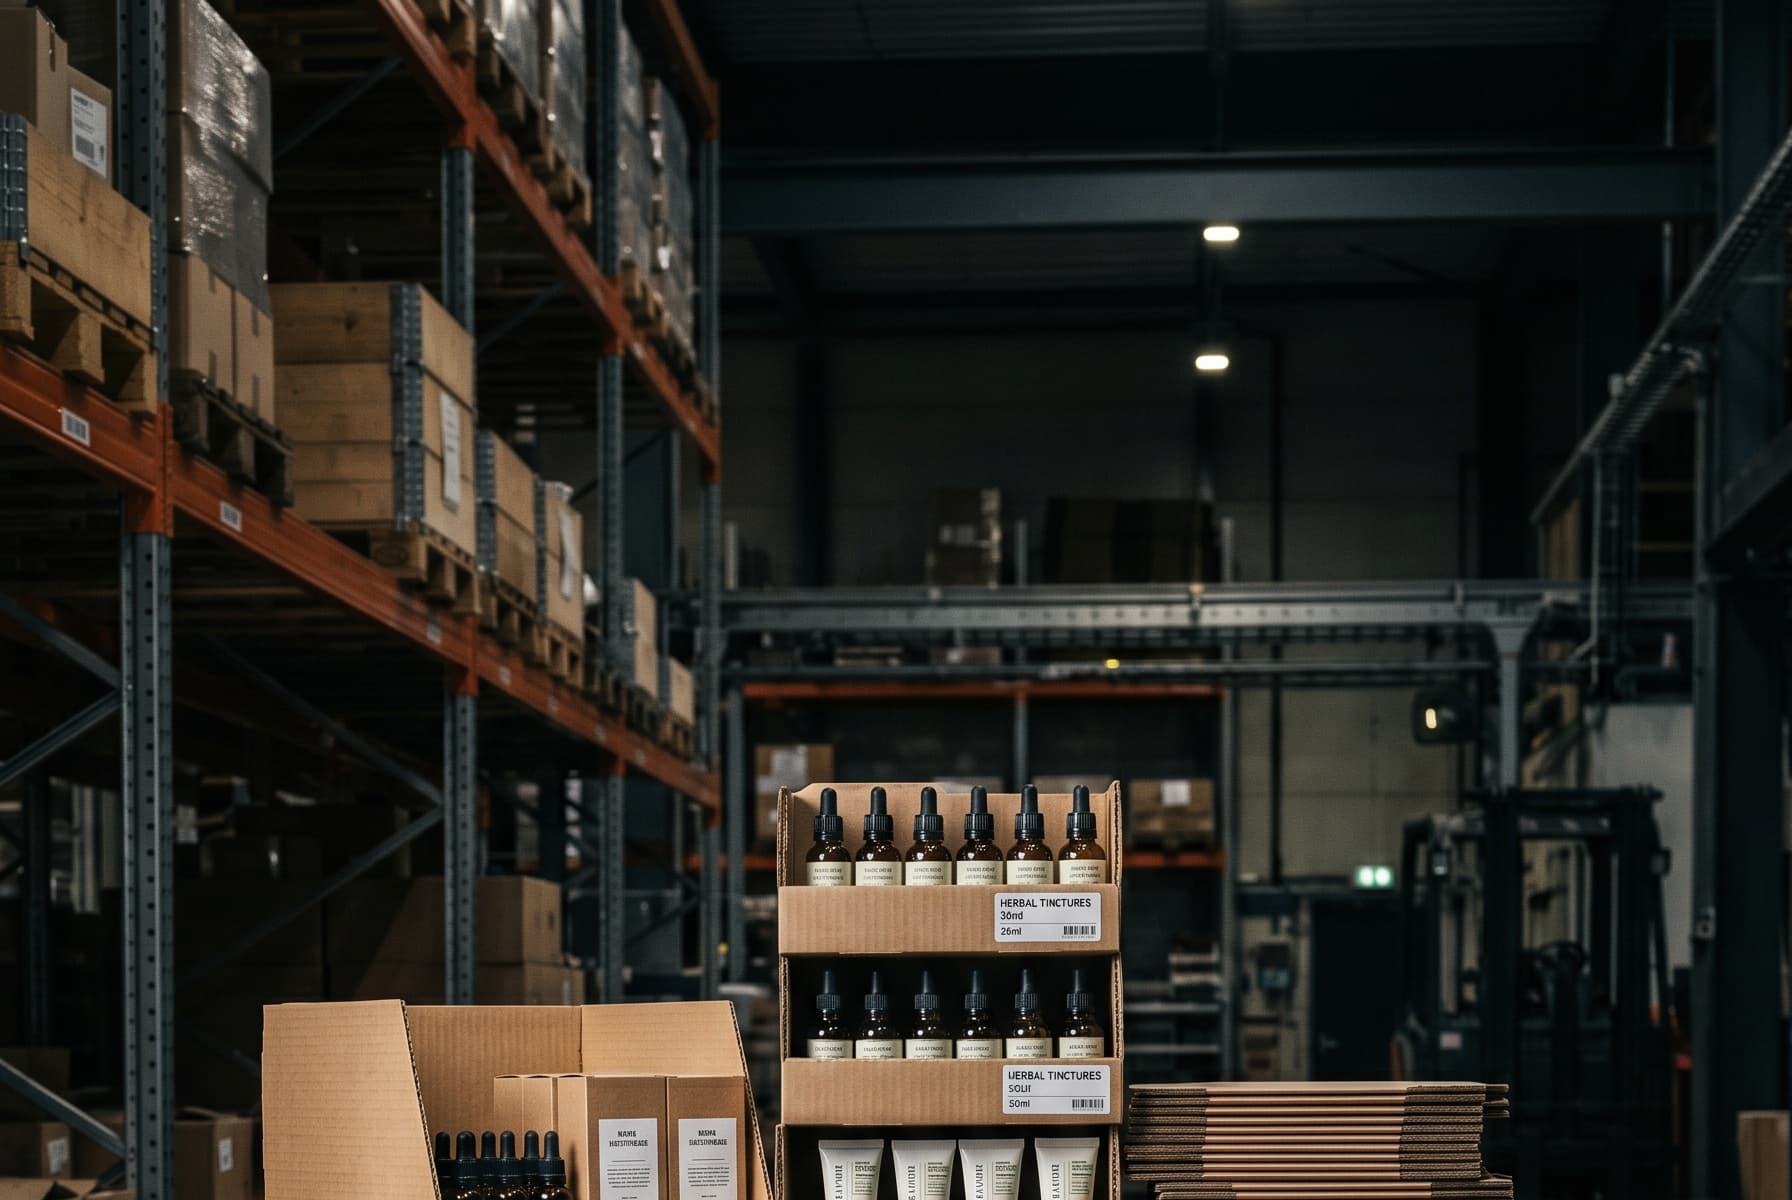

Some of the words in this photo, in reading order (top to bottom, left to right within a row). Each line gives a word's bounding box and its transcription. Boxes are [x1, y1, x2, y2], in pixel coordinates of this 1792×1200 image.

[1000, 898, 1037, 908] HERBAL
[1040, 898, 1092, 908] TINCTURES
[1048, 1071, 1102, 1080] TINCTURES
[1009, 1099, 1030, 1108] 50ml
